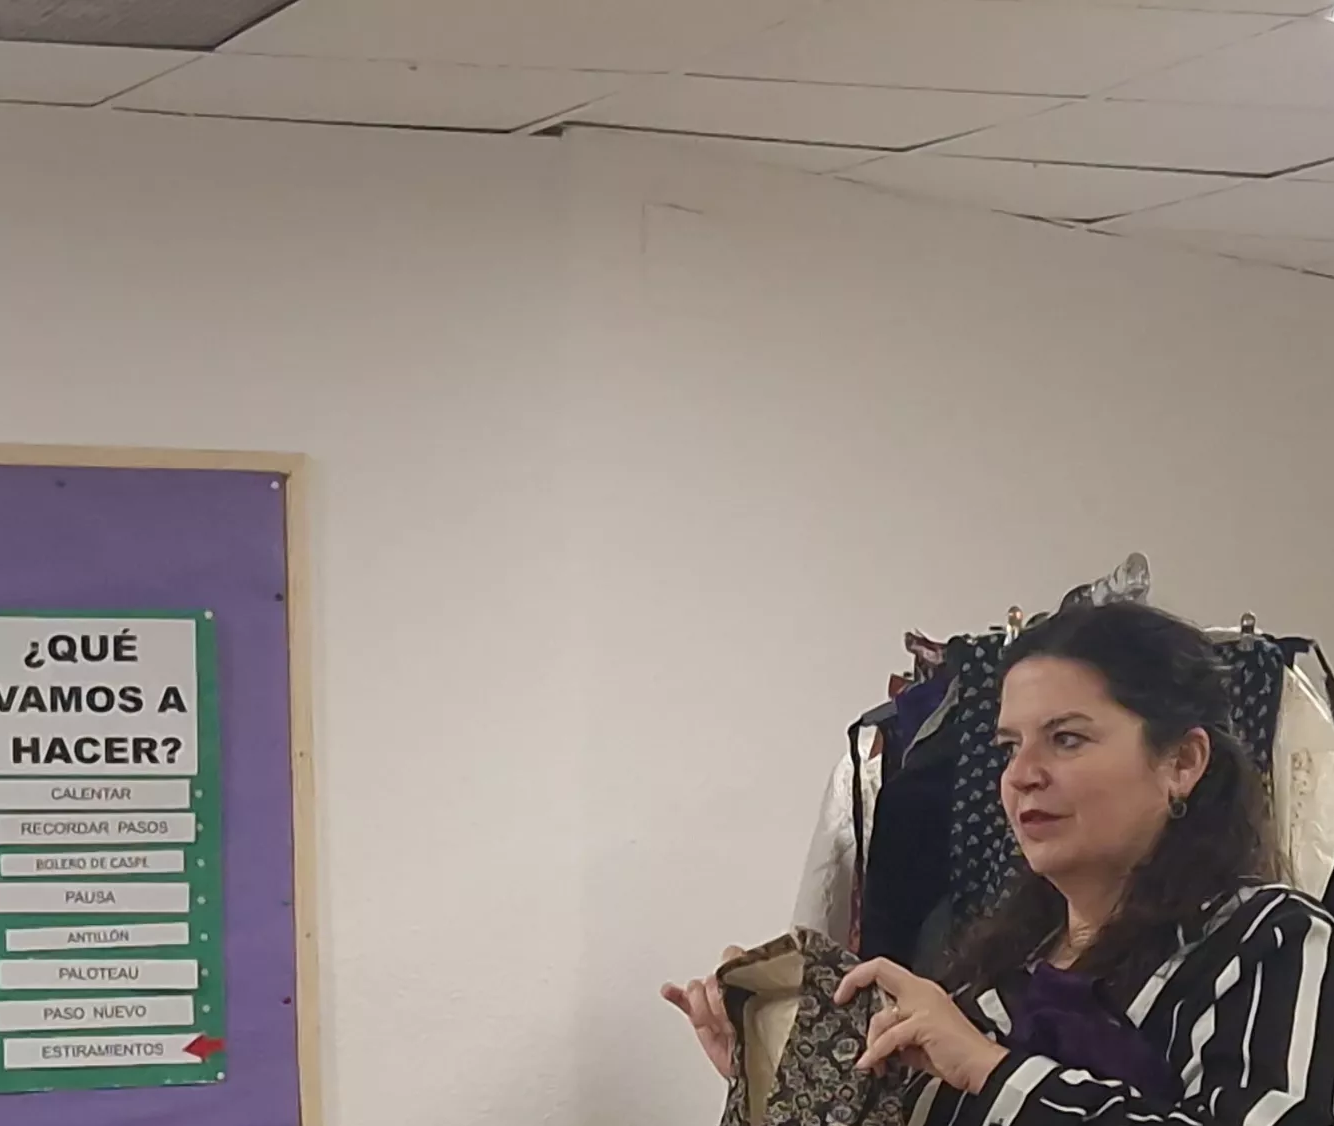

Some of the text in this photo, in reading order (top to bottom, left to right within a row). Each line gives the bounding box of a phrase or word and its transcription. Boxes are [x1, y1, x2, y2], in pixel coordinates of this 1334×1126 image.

[24, 628, 138, 669] ¿QUÉ
[157, 686, 188, 713] A
[12, 737, 182, 764] HACER?
[51, 787, 132, 801] CALENTAR
[21, 820, 169, 836] RECORDAR PASOS
[35, 856, 150, 871] BOLERO DE CASPE
[65, 890, 116, 904] PAUSA
[67, 929, 130, 944] ANTILLÓN
[58, 966, 139, 981] PALOTEAU
[43, 1004, 147, 1020] PASO NUEVO
[41, 1042, 164, 1059] ESTIRAMIENTOS
